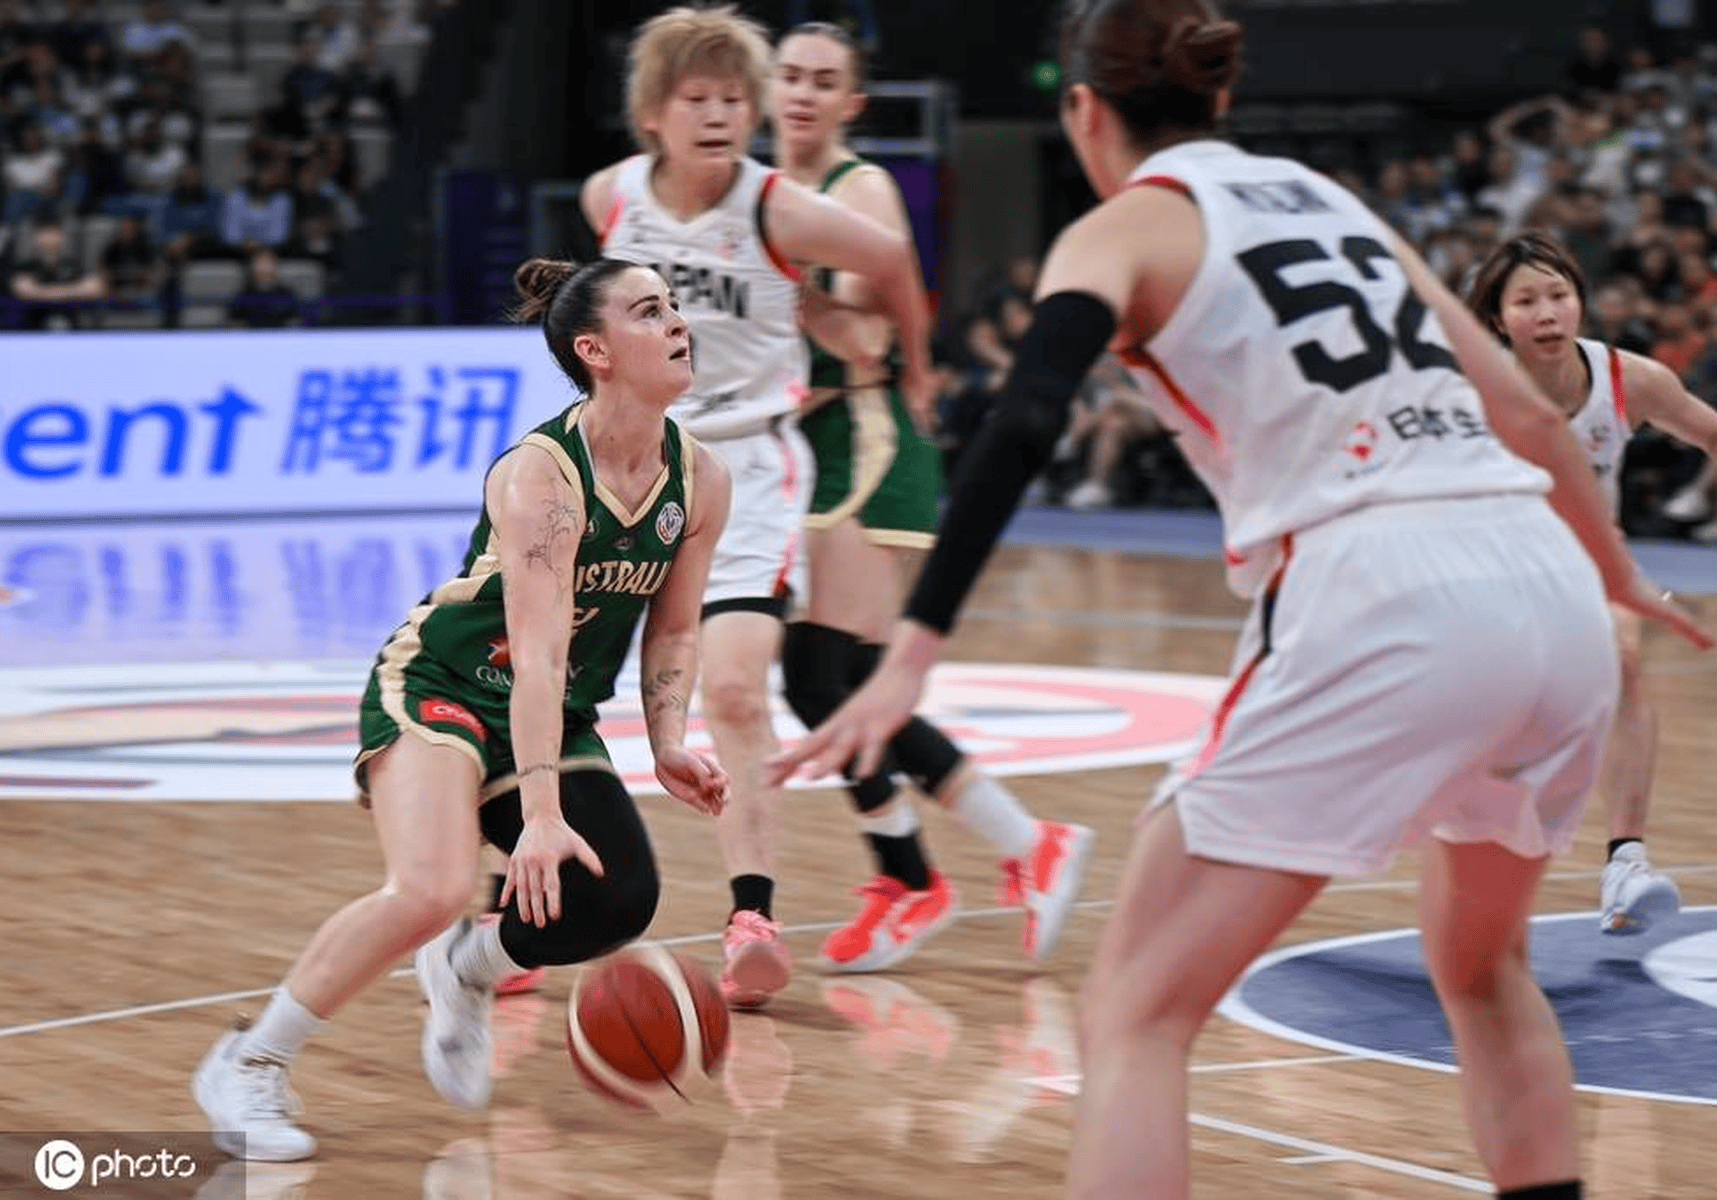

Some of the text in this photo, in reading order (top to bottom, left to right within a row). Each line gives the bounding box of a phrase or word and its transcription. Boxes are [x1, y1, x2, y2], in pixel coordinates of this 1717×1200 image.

[648, 263, 750, 319] PAN
[1234, 236, 1464, 393] 52
[3, 382, 261, 479] ent
[281, 366, 521, 473] 腾讯
